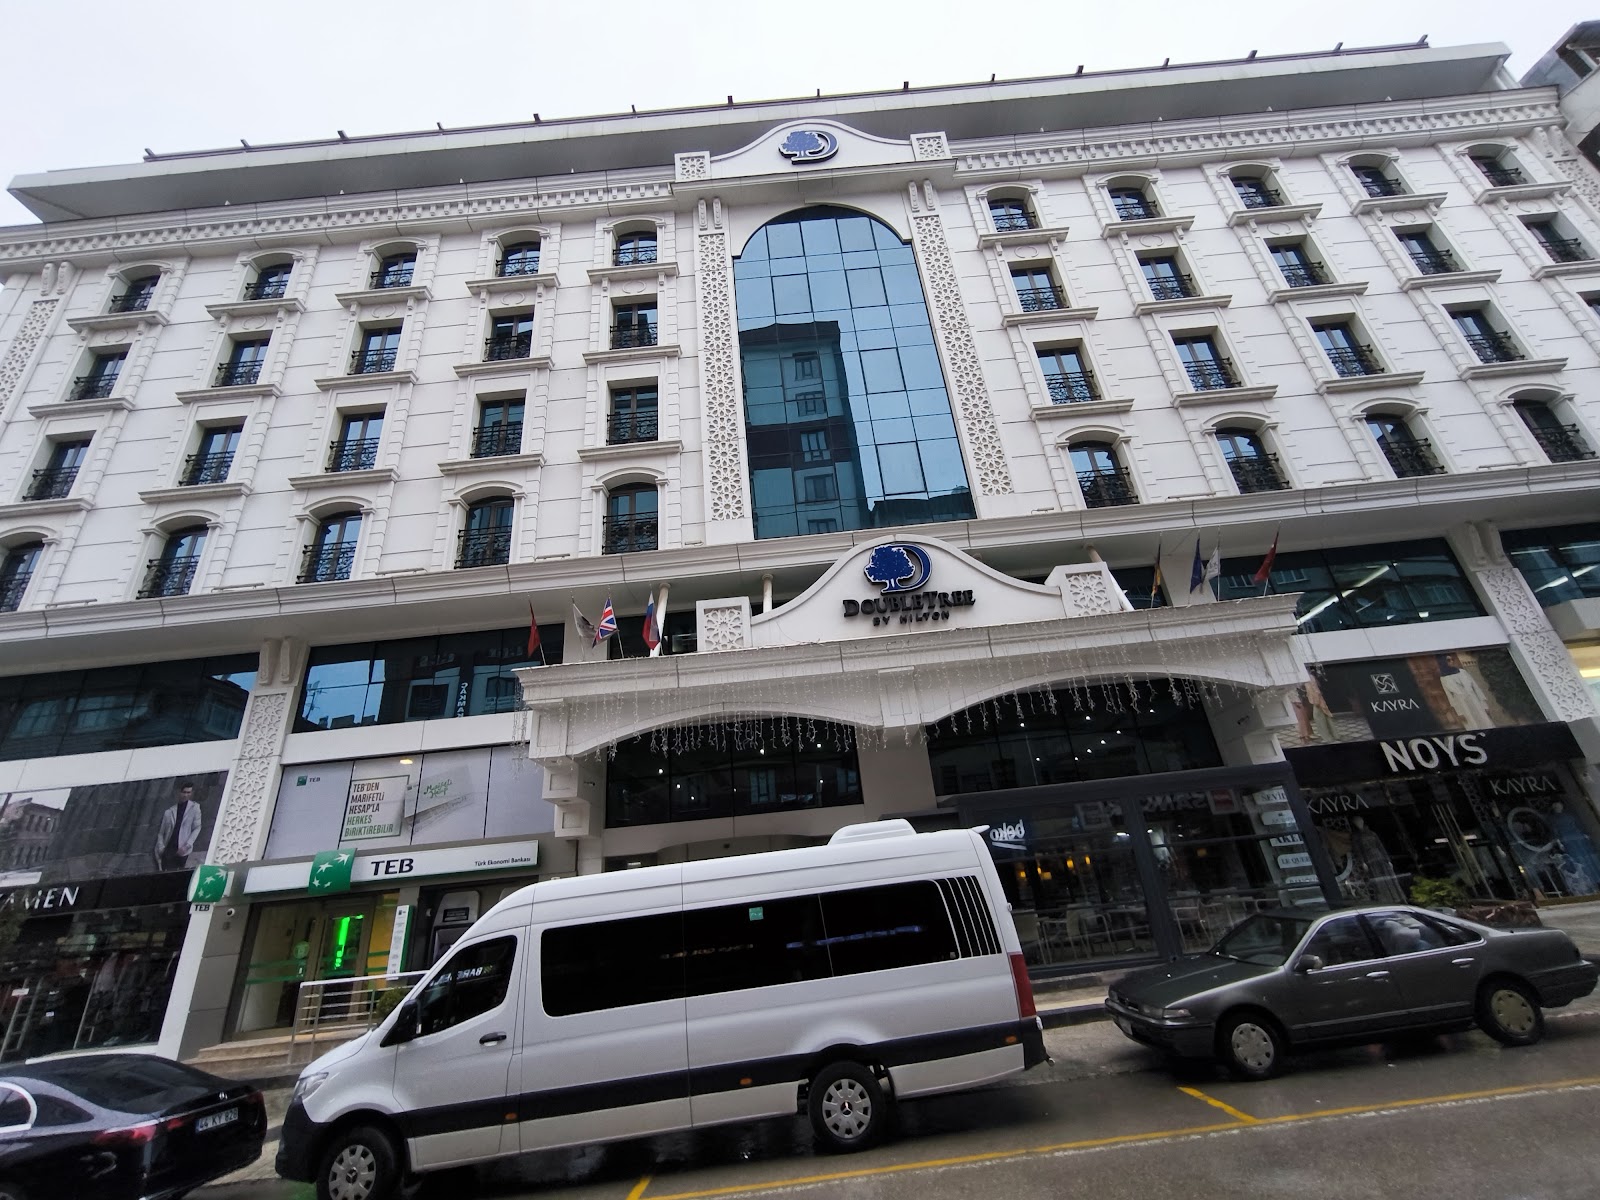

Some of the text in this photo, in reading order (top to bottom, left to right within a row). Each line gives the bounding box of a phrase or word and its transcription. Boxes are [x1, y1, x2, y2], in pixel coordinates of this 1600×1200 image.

[873, 611, 950, 626] BY HILTON
[1371, 698, 1420, 713] KAYRA
[353, 782, 380, 793] TEB'DEN
[1490, 775, 1556, 796] KAYRA
[350, 792, 385, 804] MARİFETLİ
[348, 803, 380, 815] HESAP'LA
[346, 815, 373, 826] HERKES
[370, 858, 414, 876] TEB
[487, 858, 511, 866] Ekonomi
[511, 856, 531, 864] Bankası
[194, 904, 210, 912] TEB
